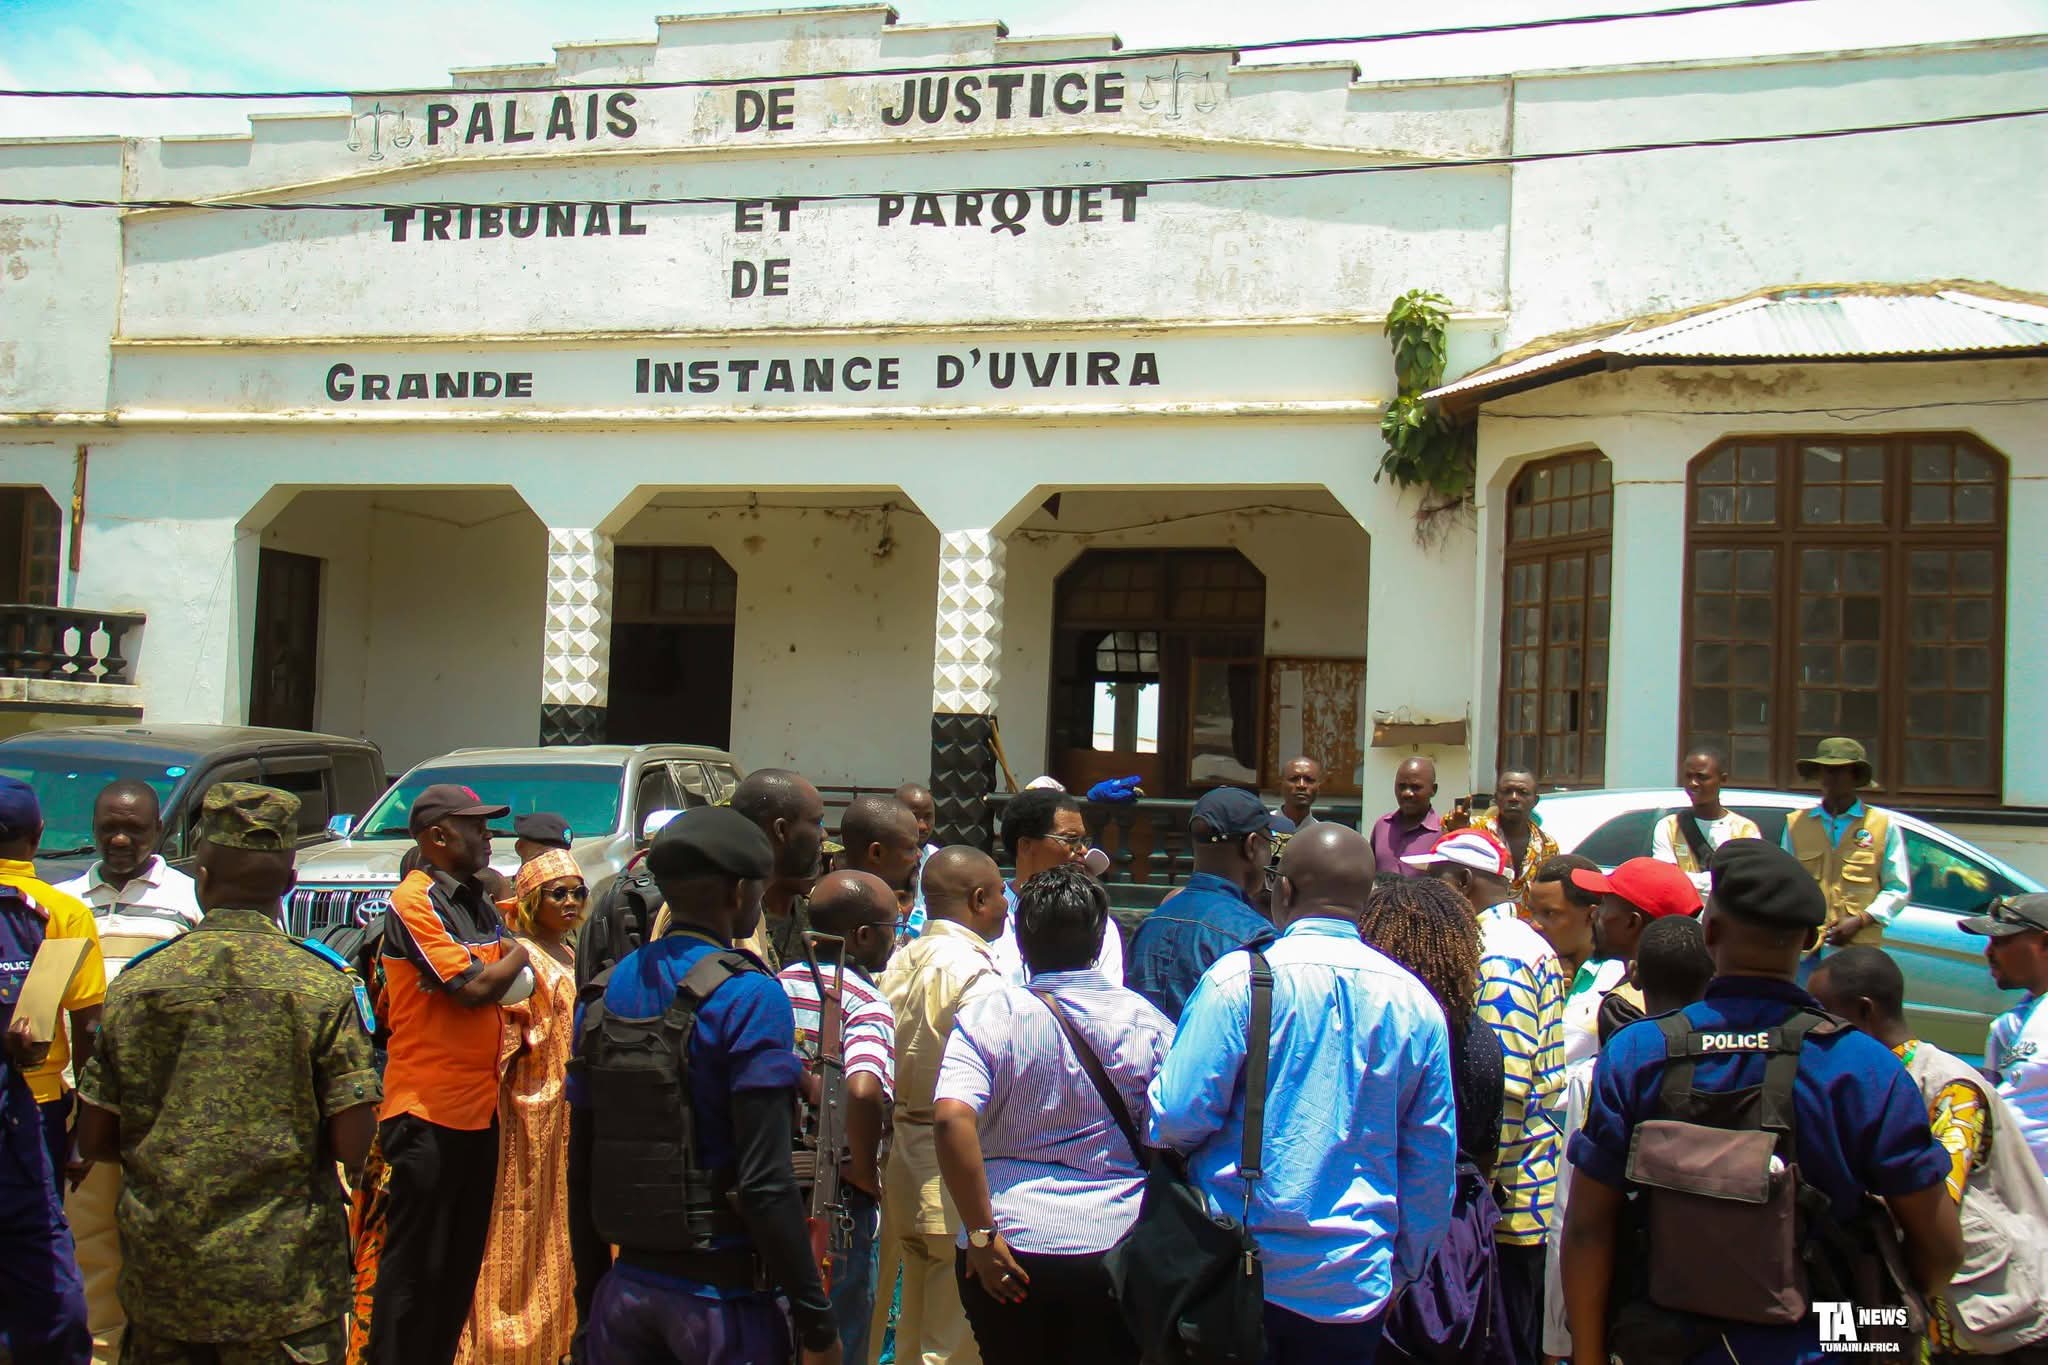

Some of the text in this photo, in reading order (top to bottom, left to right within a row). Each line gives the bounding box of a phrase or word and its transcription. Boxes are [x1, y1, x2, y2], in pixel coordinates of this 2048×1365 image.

[427, 73, 1125, 146] PALAIS DE JUSTICE
[384, 184, 1148, 242] TRIBUNAL ET PARQUET
[731, 258, 791, 298] DE
[326, 348, 1160, 401] GRANDE INSTANCE D'UVIRA
[1702, 1032, 1769, 1050] POLICE
